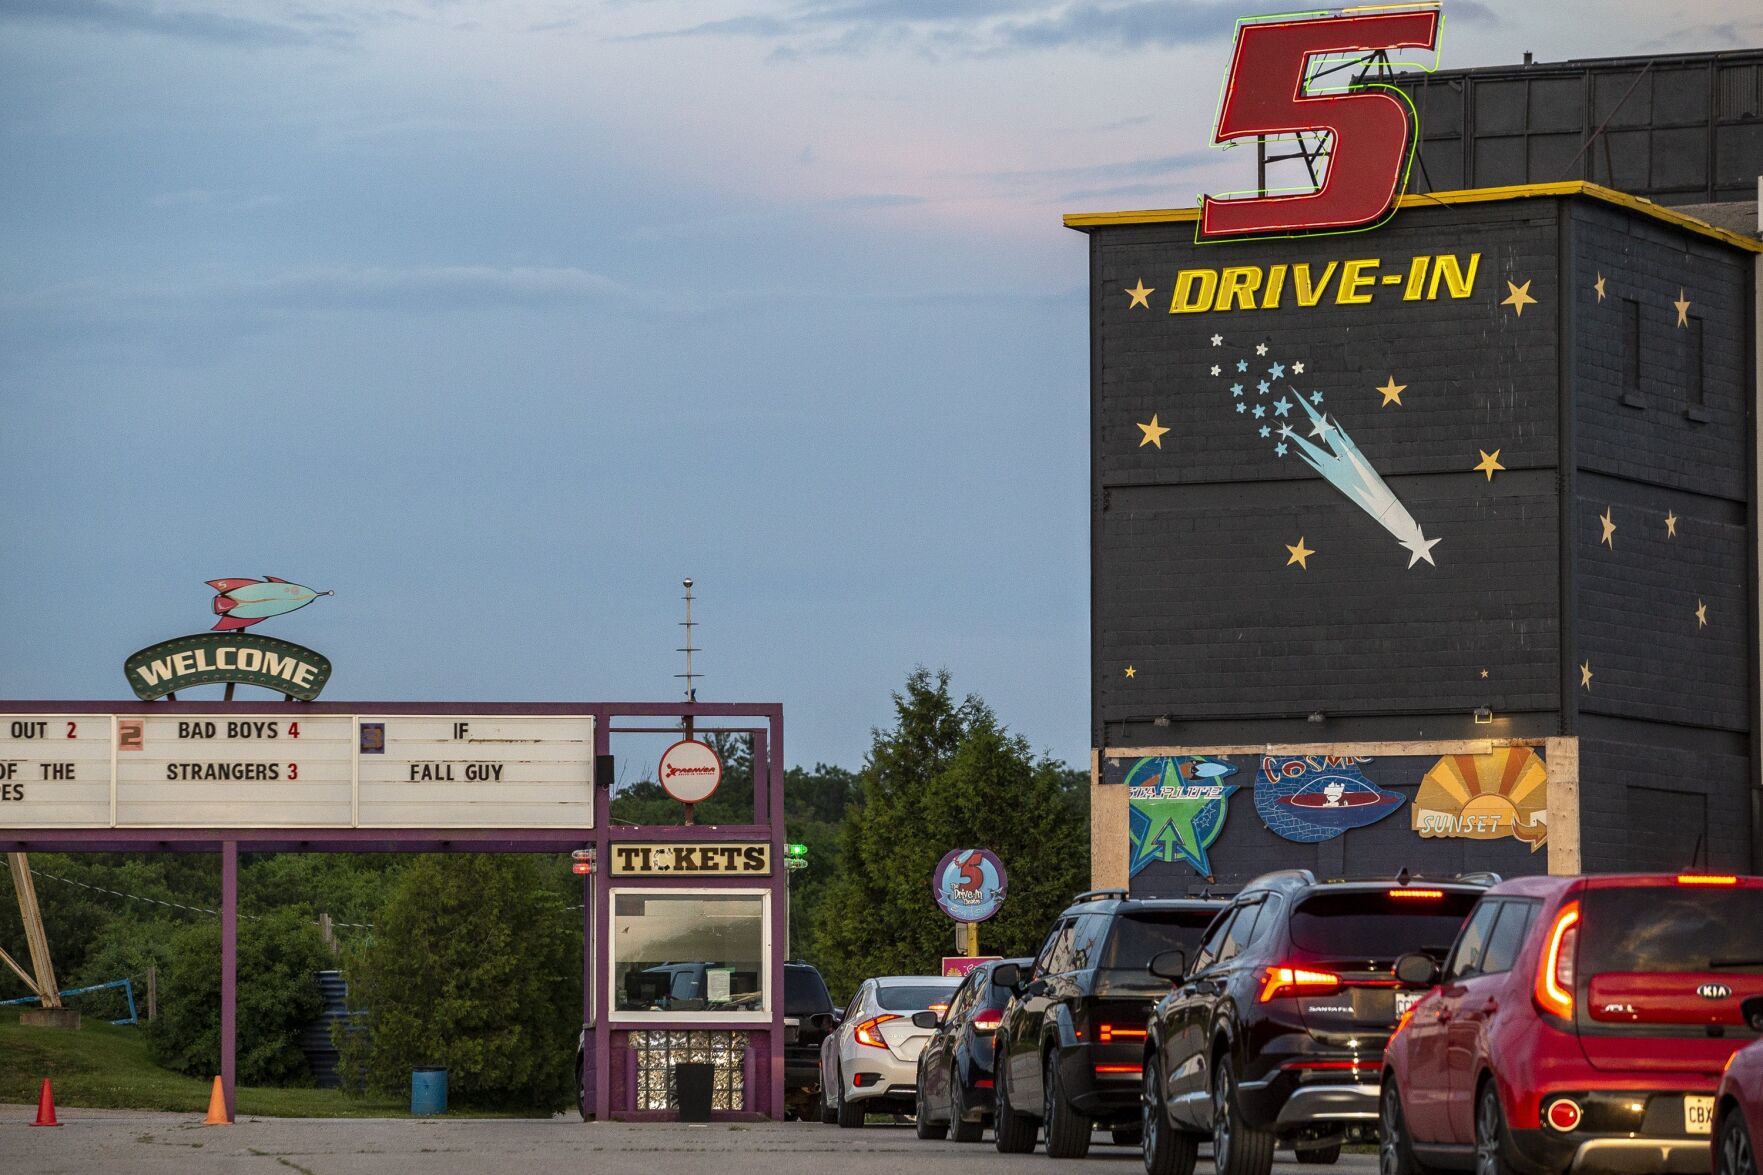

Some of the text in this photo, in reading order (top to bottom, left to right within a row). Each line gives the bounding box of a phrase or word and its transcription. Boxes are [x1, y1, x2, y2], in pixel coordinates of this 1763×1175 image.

[1197, 5, 1442, 240] 5
[1169, 252, 1481, 314] DRIVE-IN
[136, 647, 319, 689] WELCOME
[11, 721, 77, 739] OUT 2
[119, 725, 142, 746] 2
[178, 721, 300, 739] BAD BOYS 4
[453, 722, 469, 740] IF
[40, 763, 75, 780] THE
[166, 763, 298, 780] STRANGERS 3
[410, 764, 504, 781] FALL GUY
[0, 783, 25, 801] ES
[1421, 815, 1502, 833] SUNSET
[617, 847, 766, 871] TICKETS
[959, 852, 984, 892] 5
[1703, 986, 1727, 997] KIA
[1689, 1106, 1712, 1124] CBX
